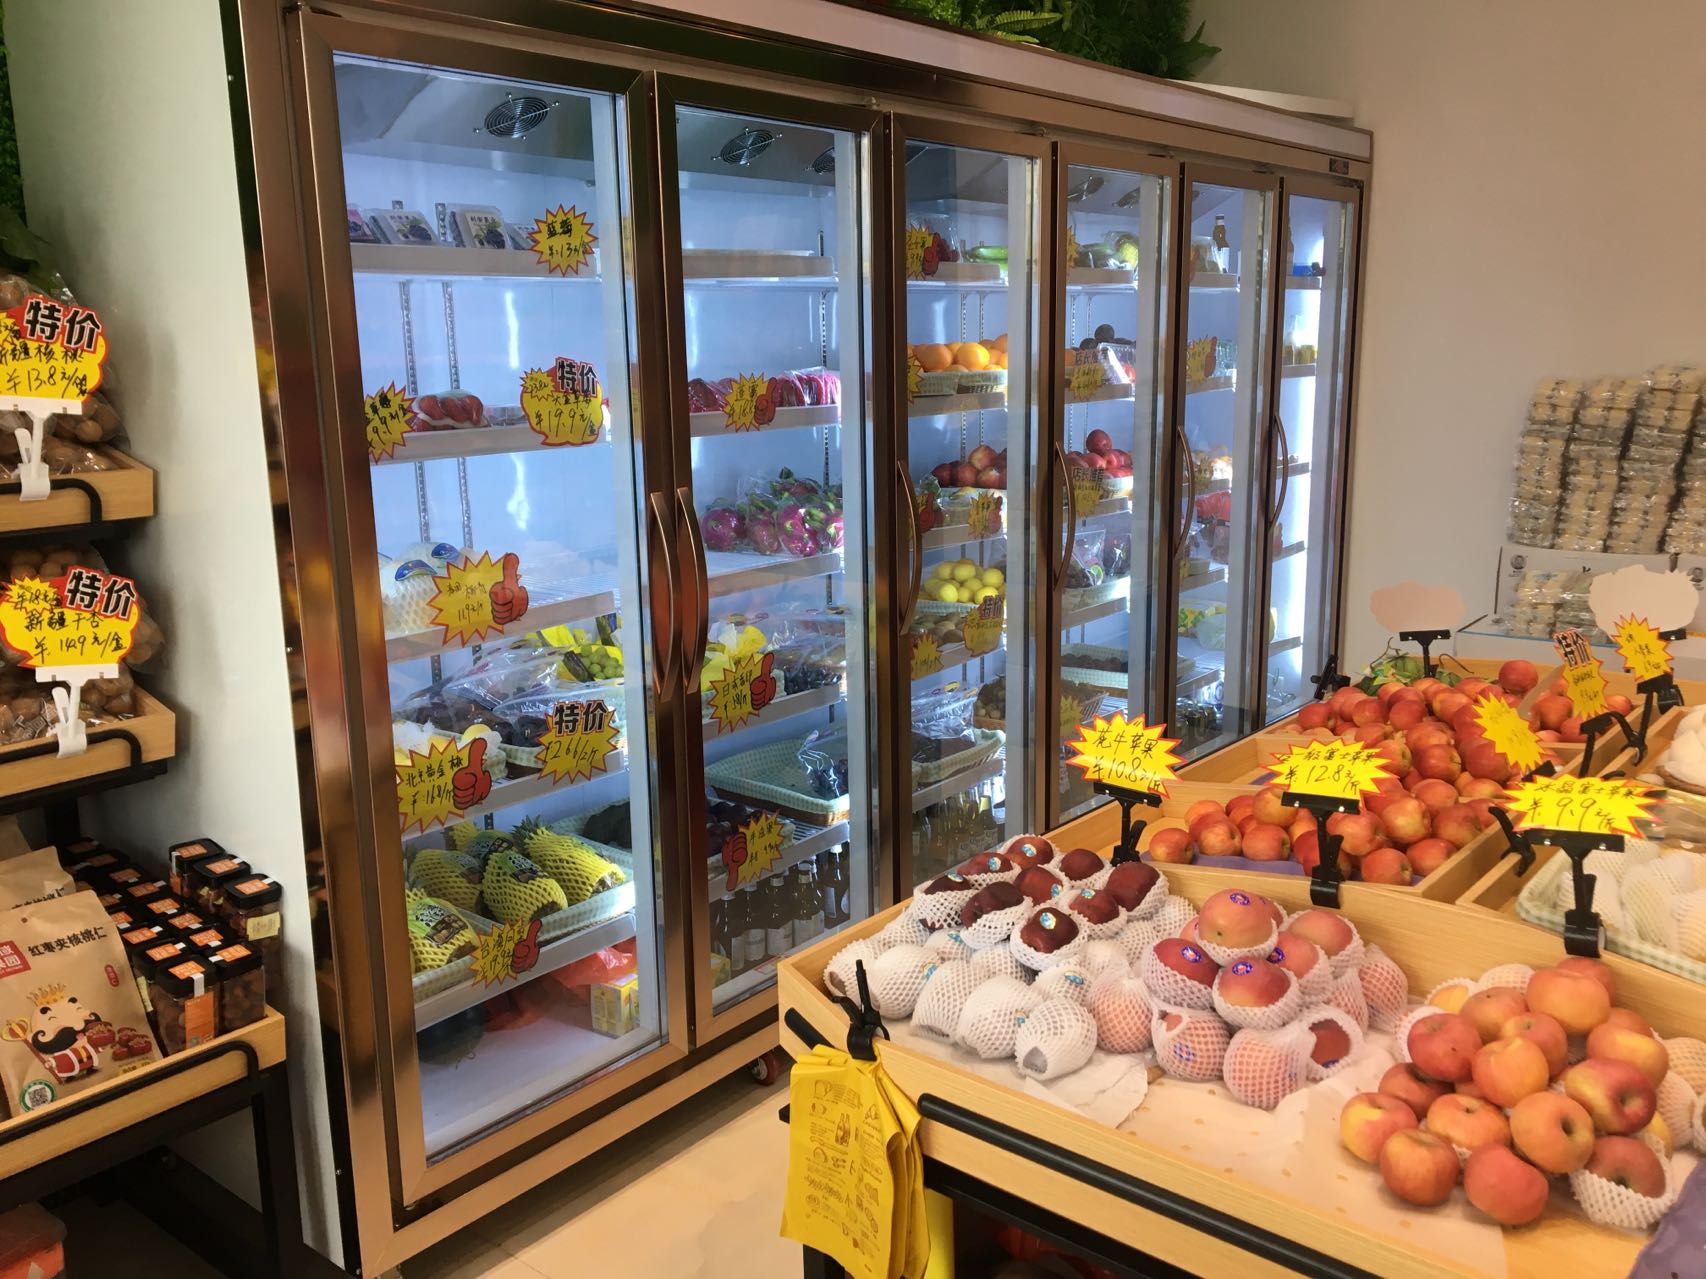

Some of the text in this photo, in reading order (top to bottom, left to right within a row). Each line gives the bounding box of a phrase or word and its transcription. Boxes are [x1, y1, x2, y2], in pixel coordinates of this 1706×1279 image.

[24, 299, 102, 350] 特价
[557, 360, 597, 396] 特价
[66, 569, 136, 617] 特价
[554, 702, 607, 736] 特价
[1092, 726, 1158, 760] 花牛苹果
[27, 926, 108, 957] 红枣夹核桃仁
